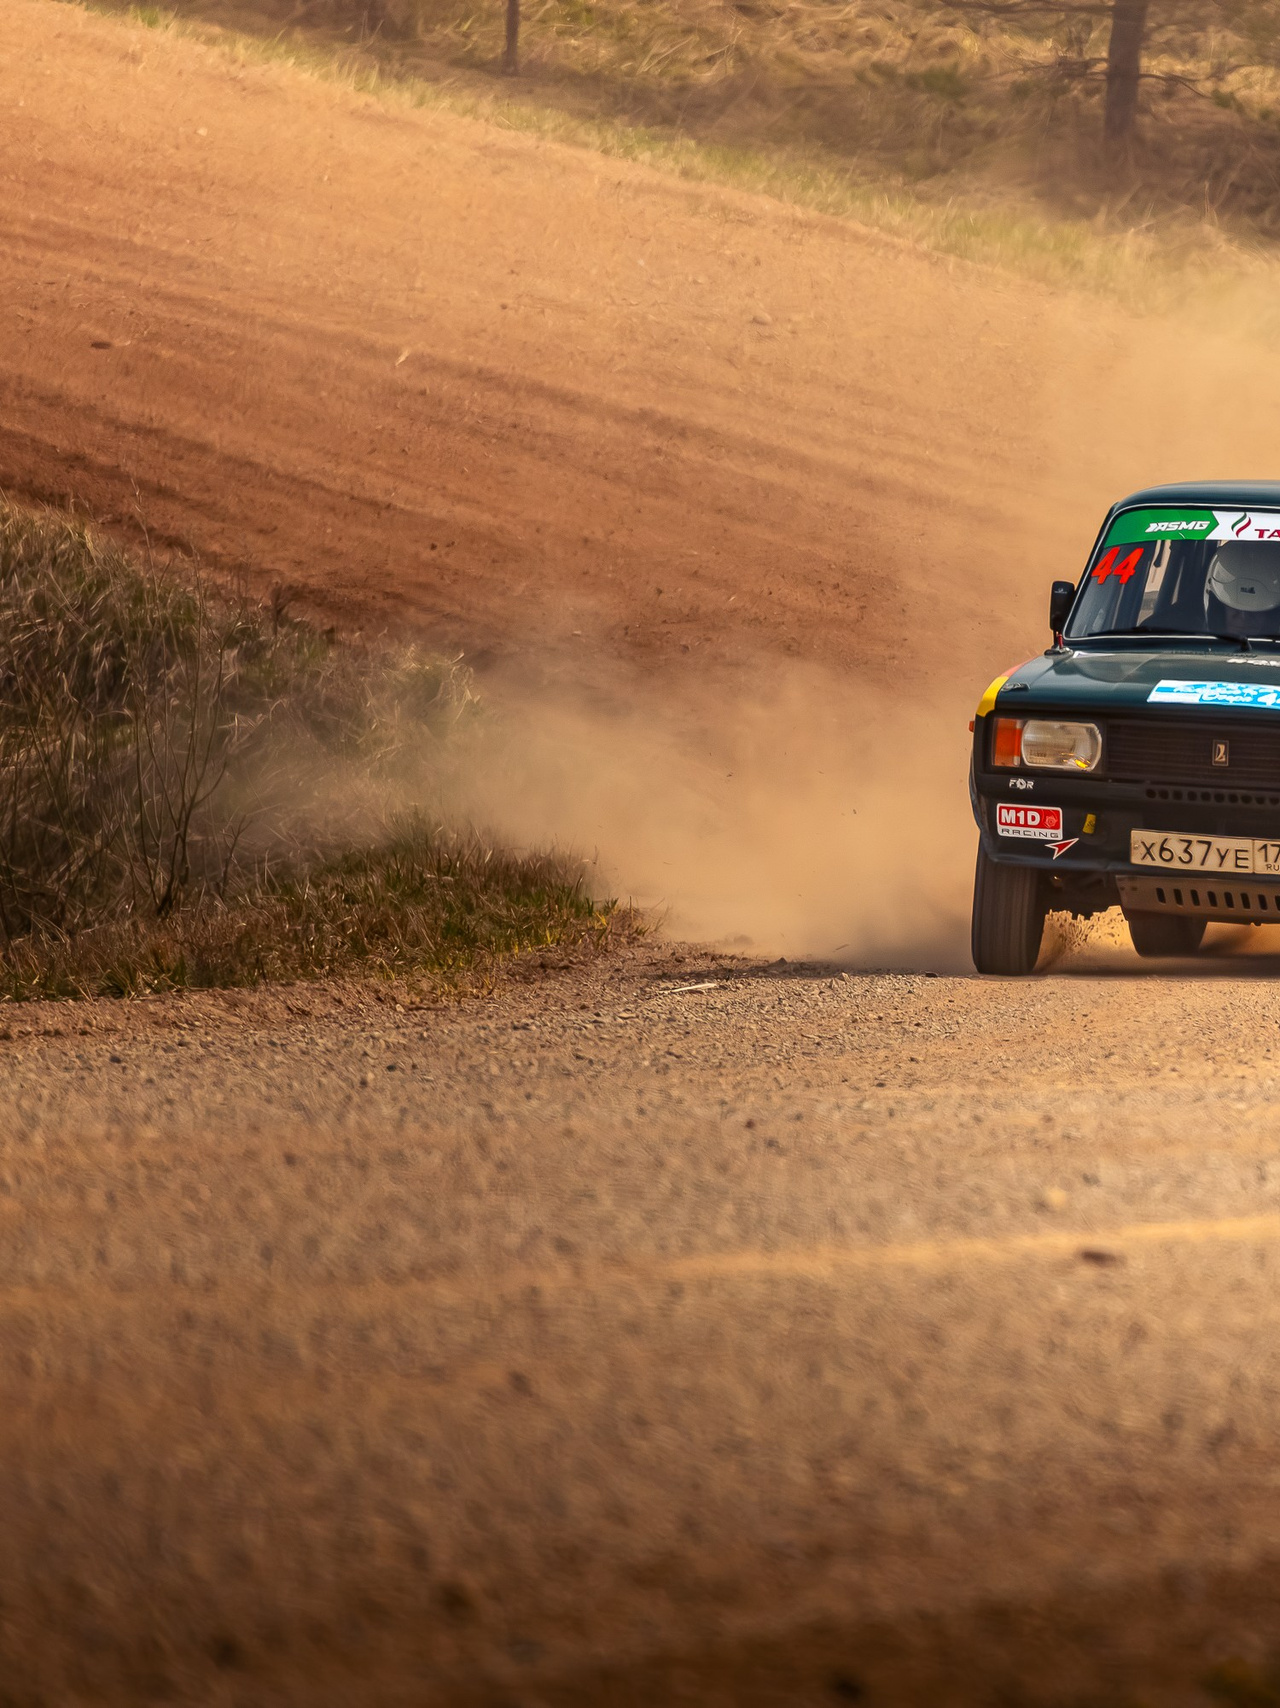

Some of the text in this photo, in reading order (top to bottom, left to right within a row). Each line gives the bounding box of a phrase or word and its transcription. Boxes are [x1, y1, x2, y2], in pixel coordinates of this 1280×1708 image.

[1091, 546, 1144, 585] 44
[1001, 808, 1040, 826] M1D
[1001, 828, 1059, 839] RACING
